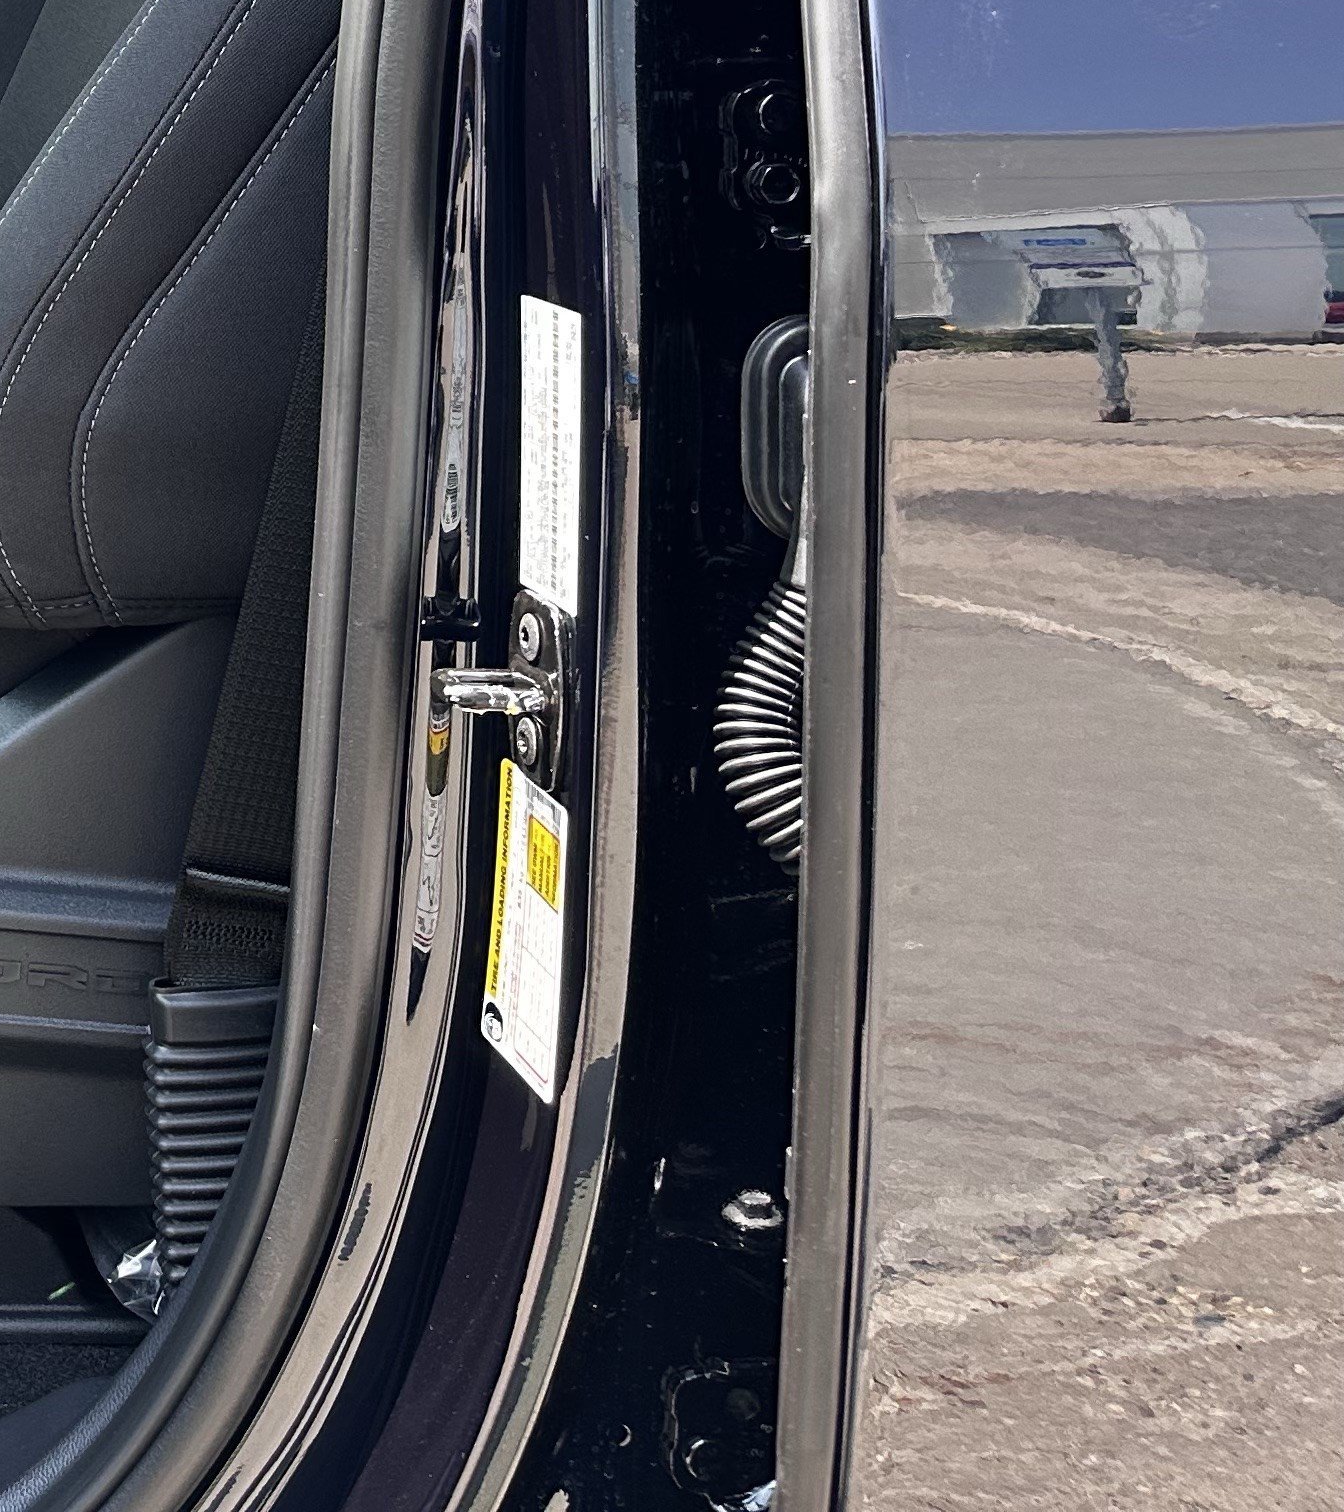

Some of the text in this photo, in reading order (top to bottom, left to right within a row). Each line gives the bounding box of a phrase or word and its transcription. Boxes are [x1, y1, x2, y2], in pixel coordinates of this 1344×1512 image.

[501, 766, 513, 863] INFORMATION
[497, 866, 507, 926] LOADING
[490, 961, 500, 992] TIRE
